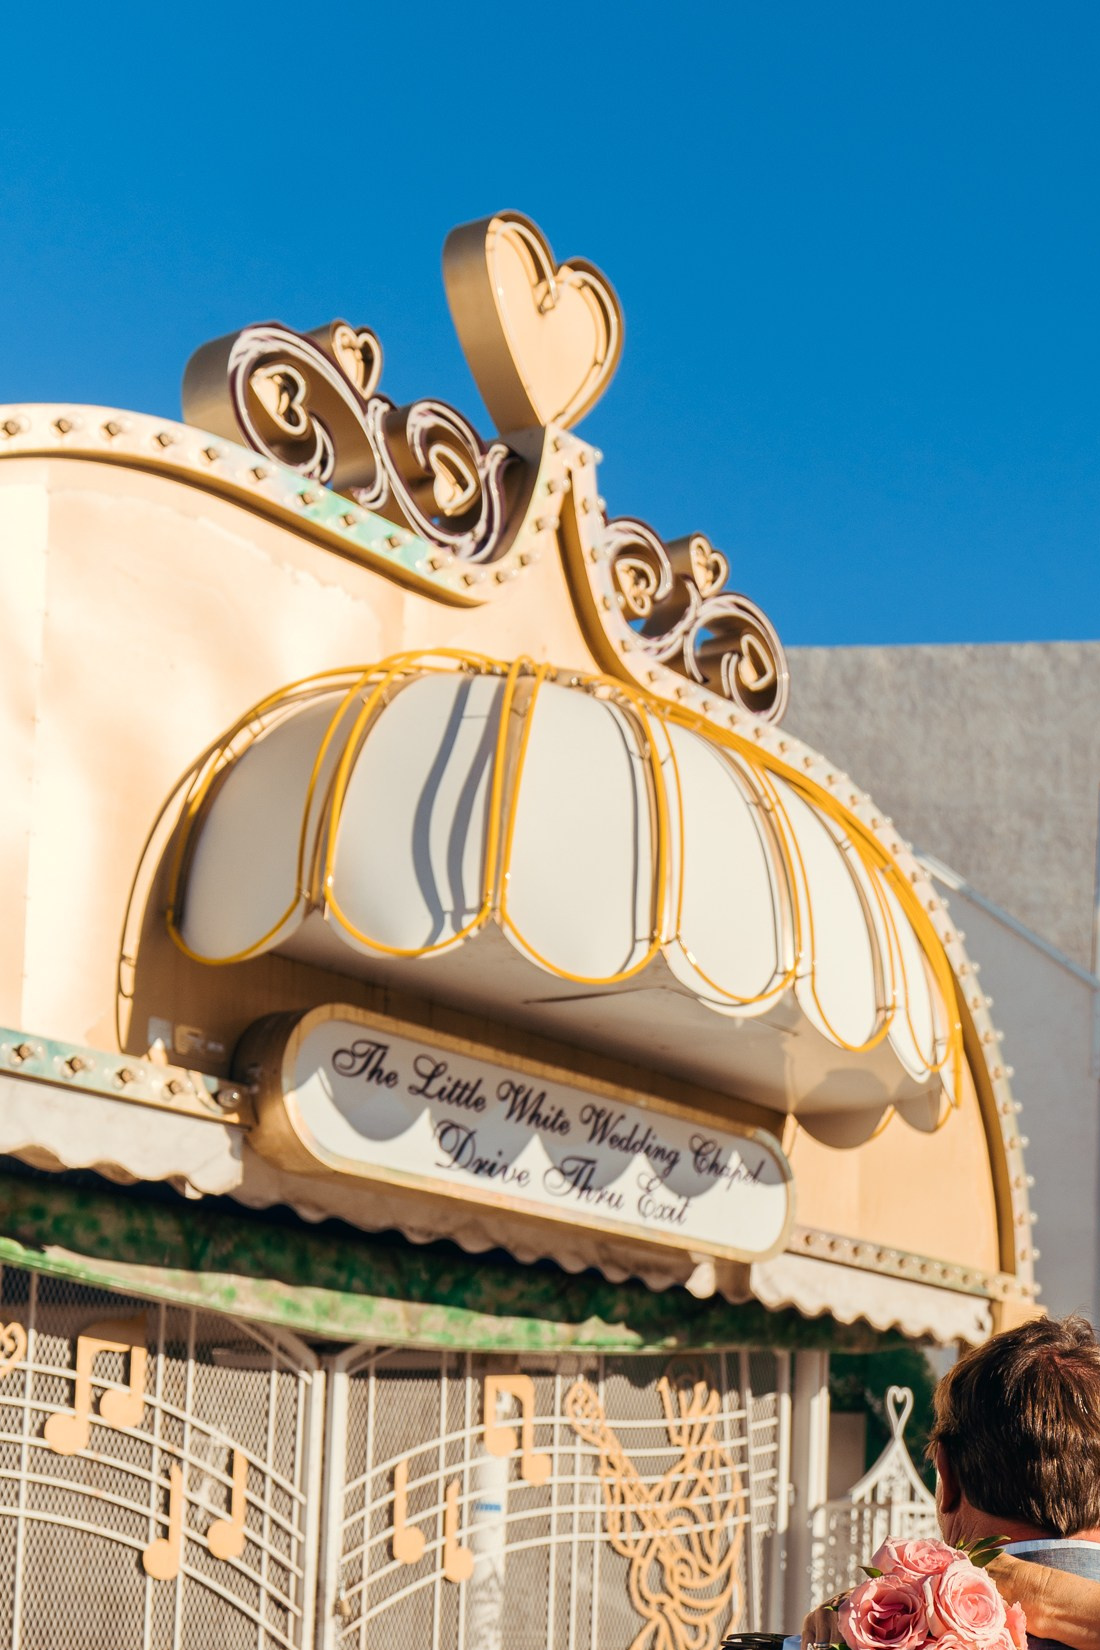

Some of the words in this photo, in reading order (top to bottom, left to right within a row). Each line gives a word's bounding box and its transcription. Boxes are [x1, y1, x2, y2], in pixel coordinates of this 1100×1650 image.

[332, 1039, 399, 1088] The
[408, 1053, 487, 1113] Little
[496, 1079, 571, 1136] White
[579, 1103, 681, 1178] Wedding
[688, 1134, 766, 1190] Chapel
[434, 1119, 530, 1186] Drive
[543, 1155, 625, 1212] Thru
[637, 1172, 693, 1225] Exit
